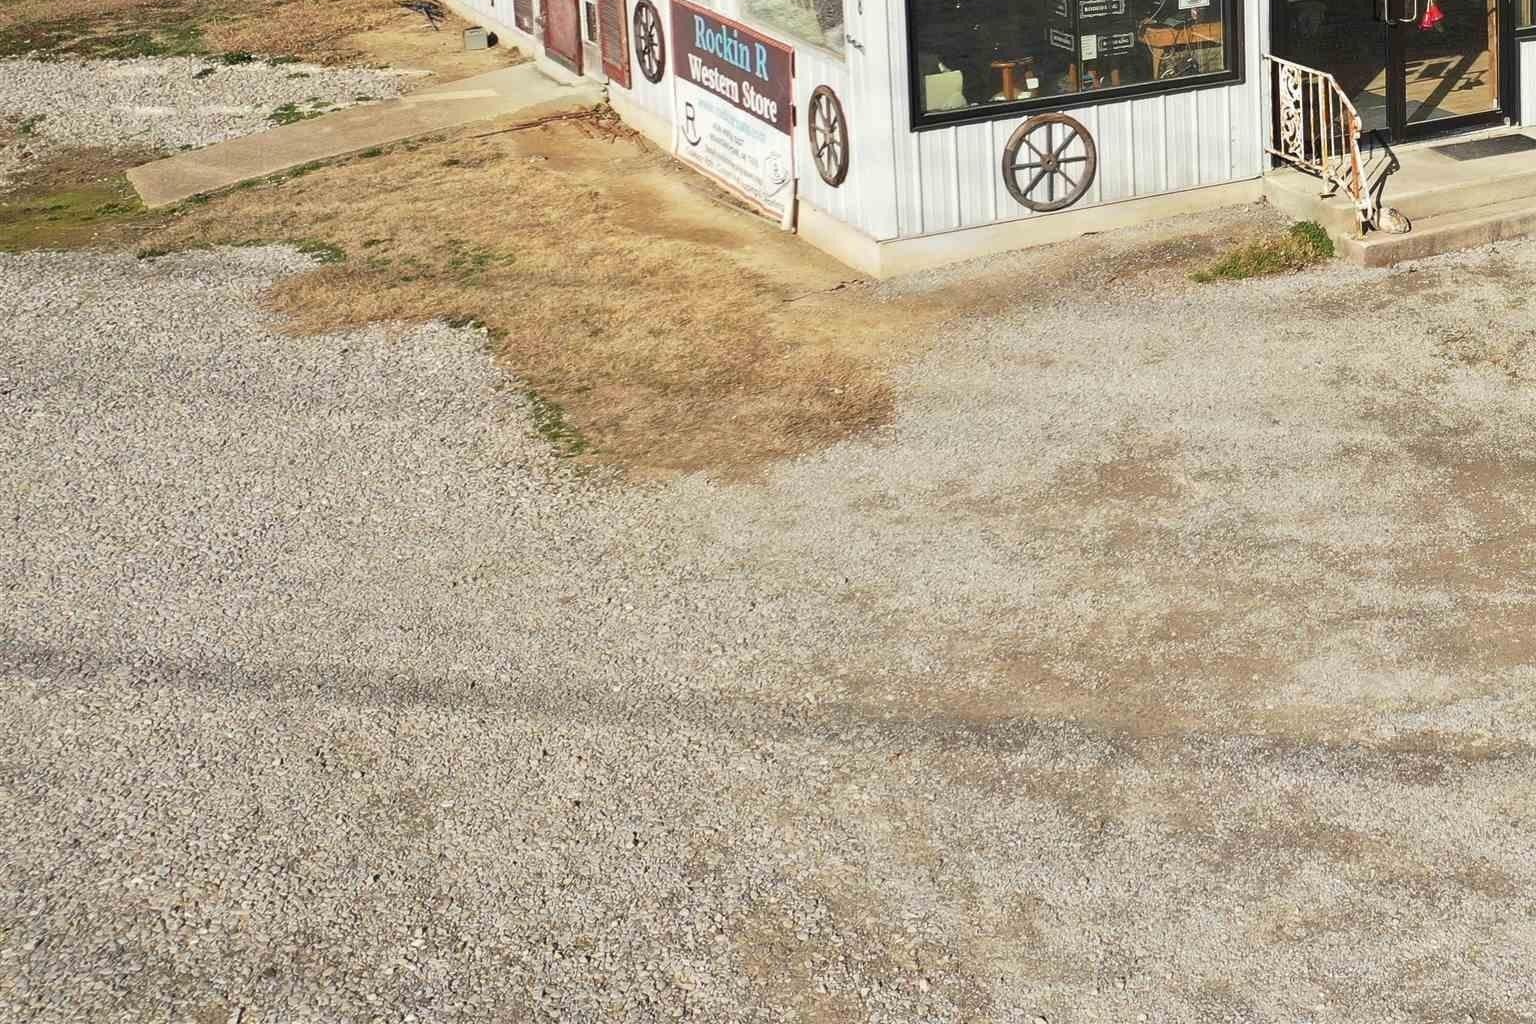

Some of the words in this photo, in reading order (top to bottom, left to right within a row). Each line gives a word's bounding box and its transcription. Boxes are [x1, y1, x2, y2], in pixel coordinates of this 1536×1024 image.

[694, 14, 751, 72] Rockin
[755, 42, 769, 81] R
[688, 53, 740, 104] Western
[742, 80, 778, 123] Store
